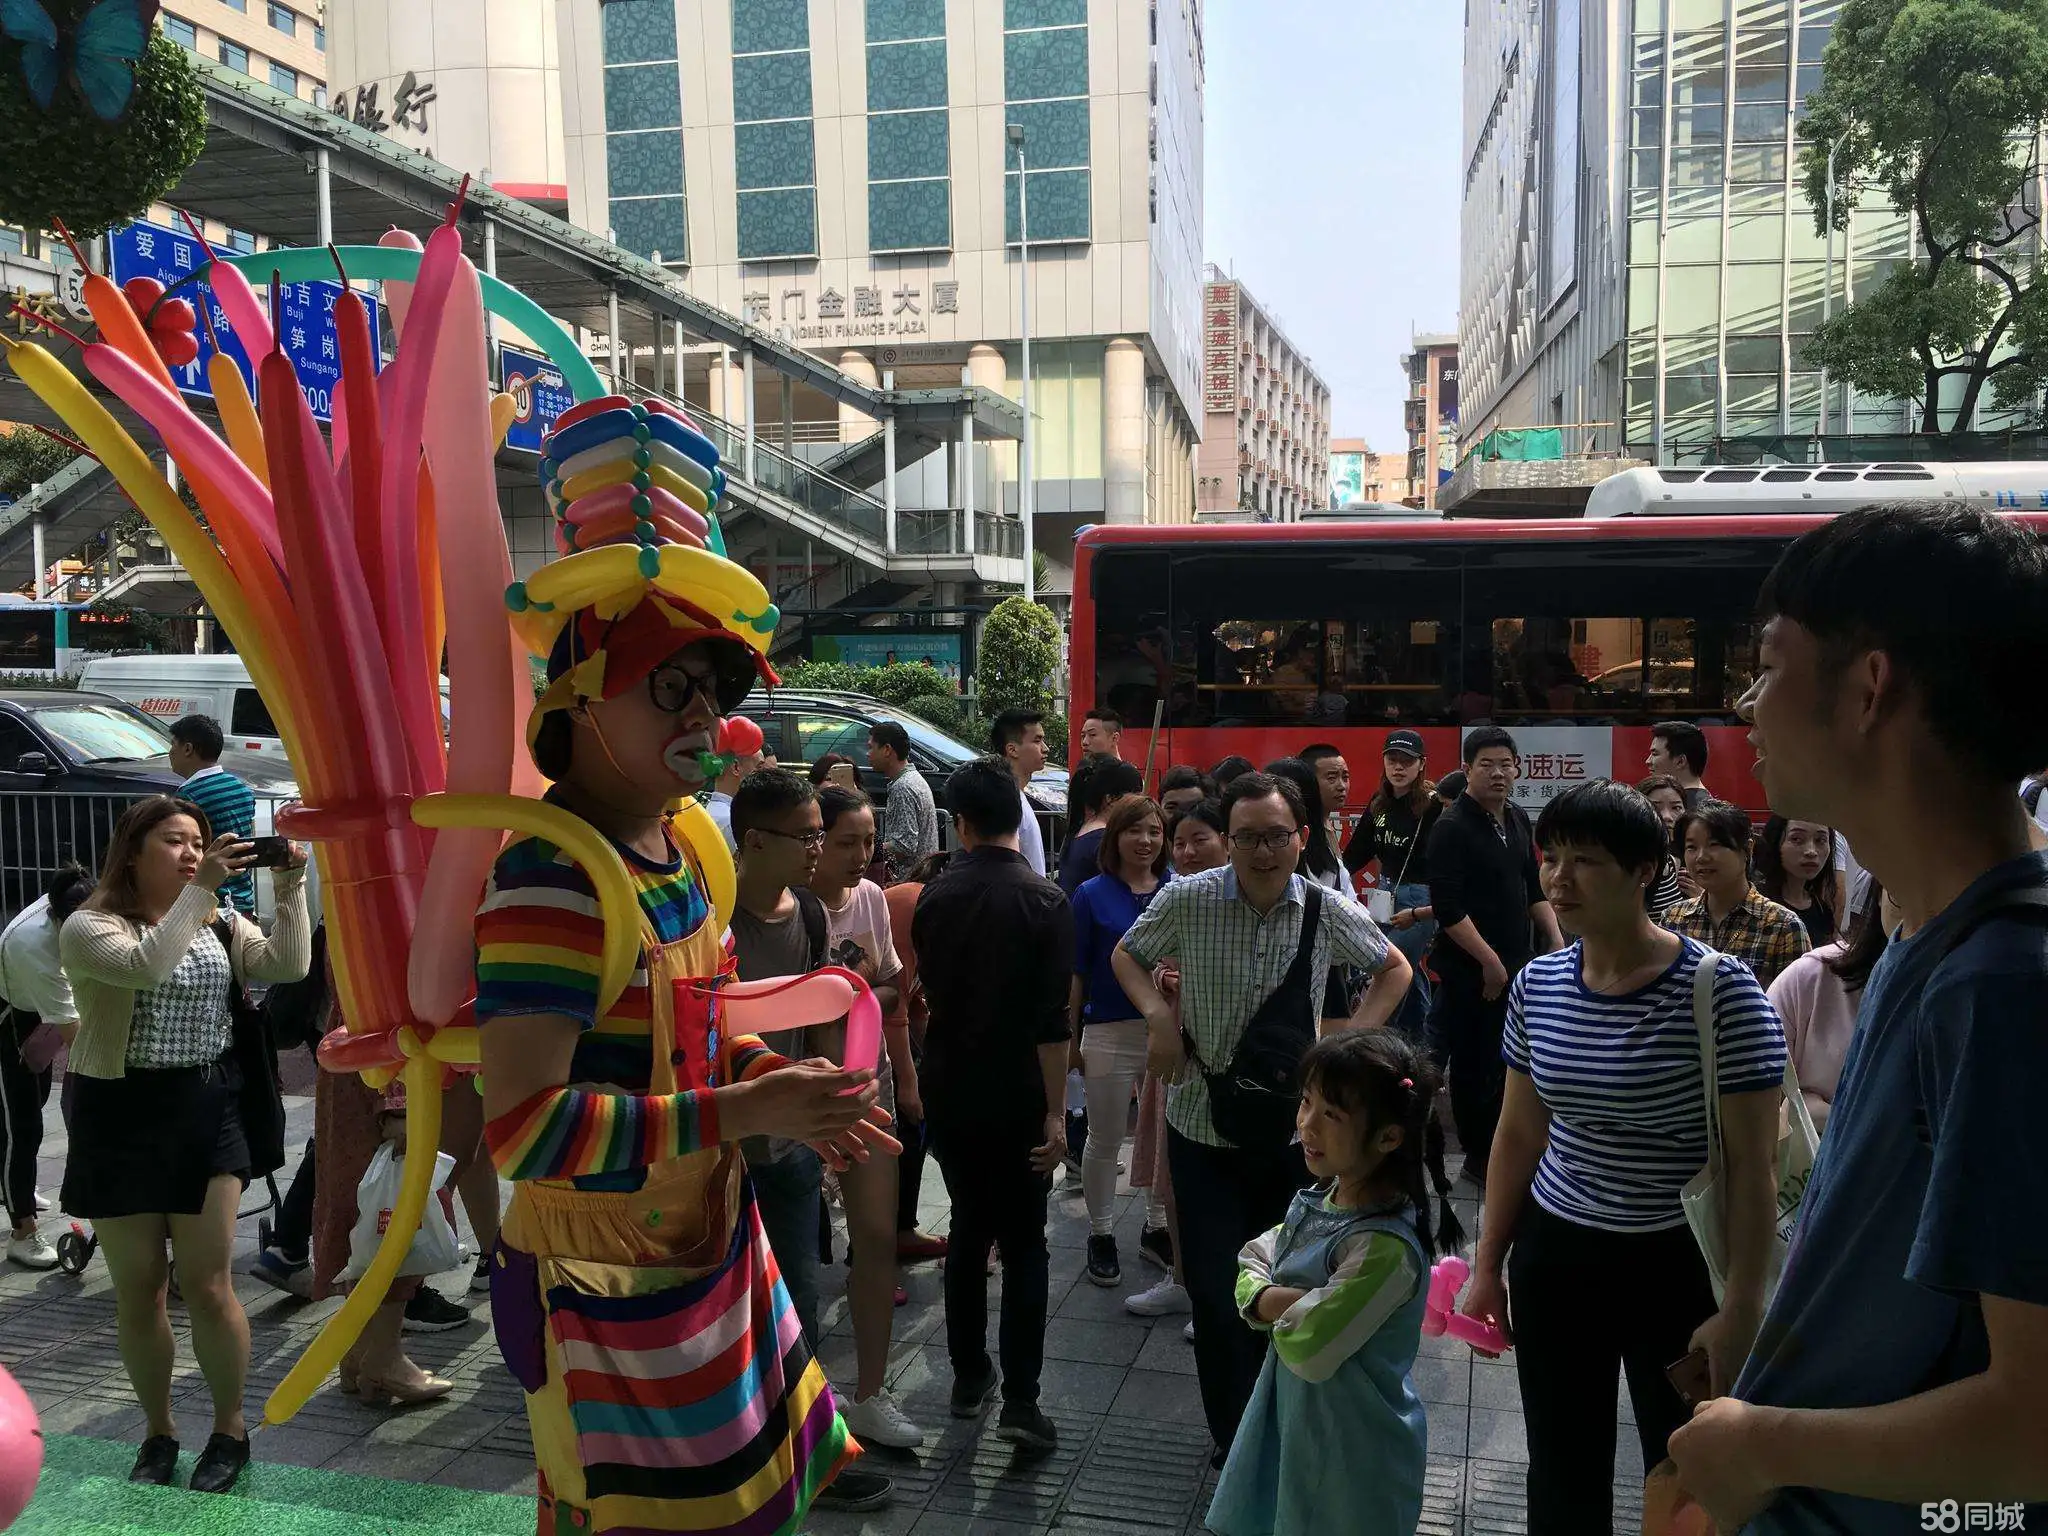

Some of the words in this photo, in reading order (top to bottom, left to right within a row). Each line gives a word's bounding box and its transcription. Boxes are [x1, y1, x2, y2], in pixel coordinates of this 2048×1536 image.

[157, 267, 189, 286] Aigu
[743, 280, 959, 322] 东门金融大厦
[286, 305, 304, 322] Buji
[775, 326, 832, 340] DNGMEN
[835, 322, 885, 338] FINANCE
[888, 320, 927, 335] PLAZA
[300, 356, 338, 379] Sungang
